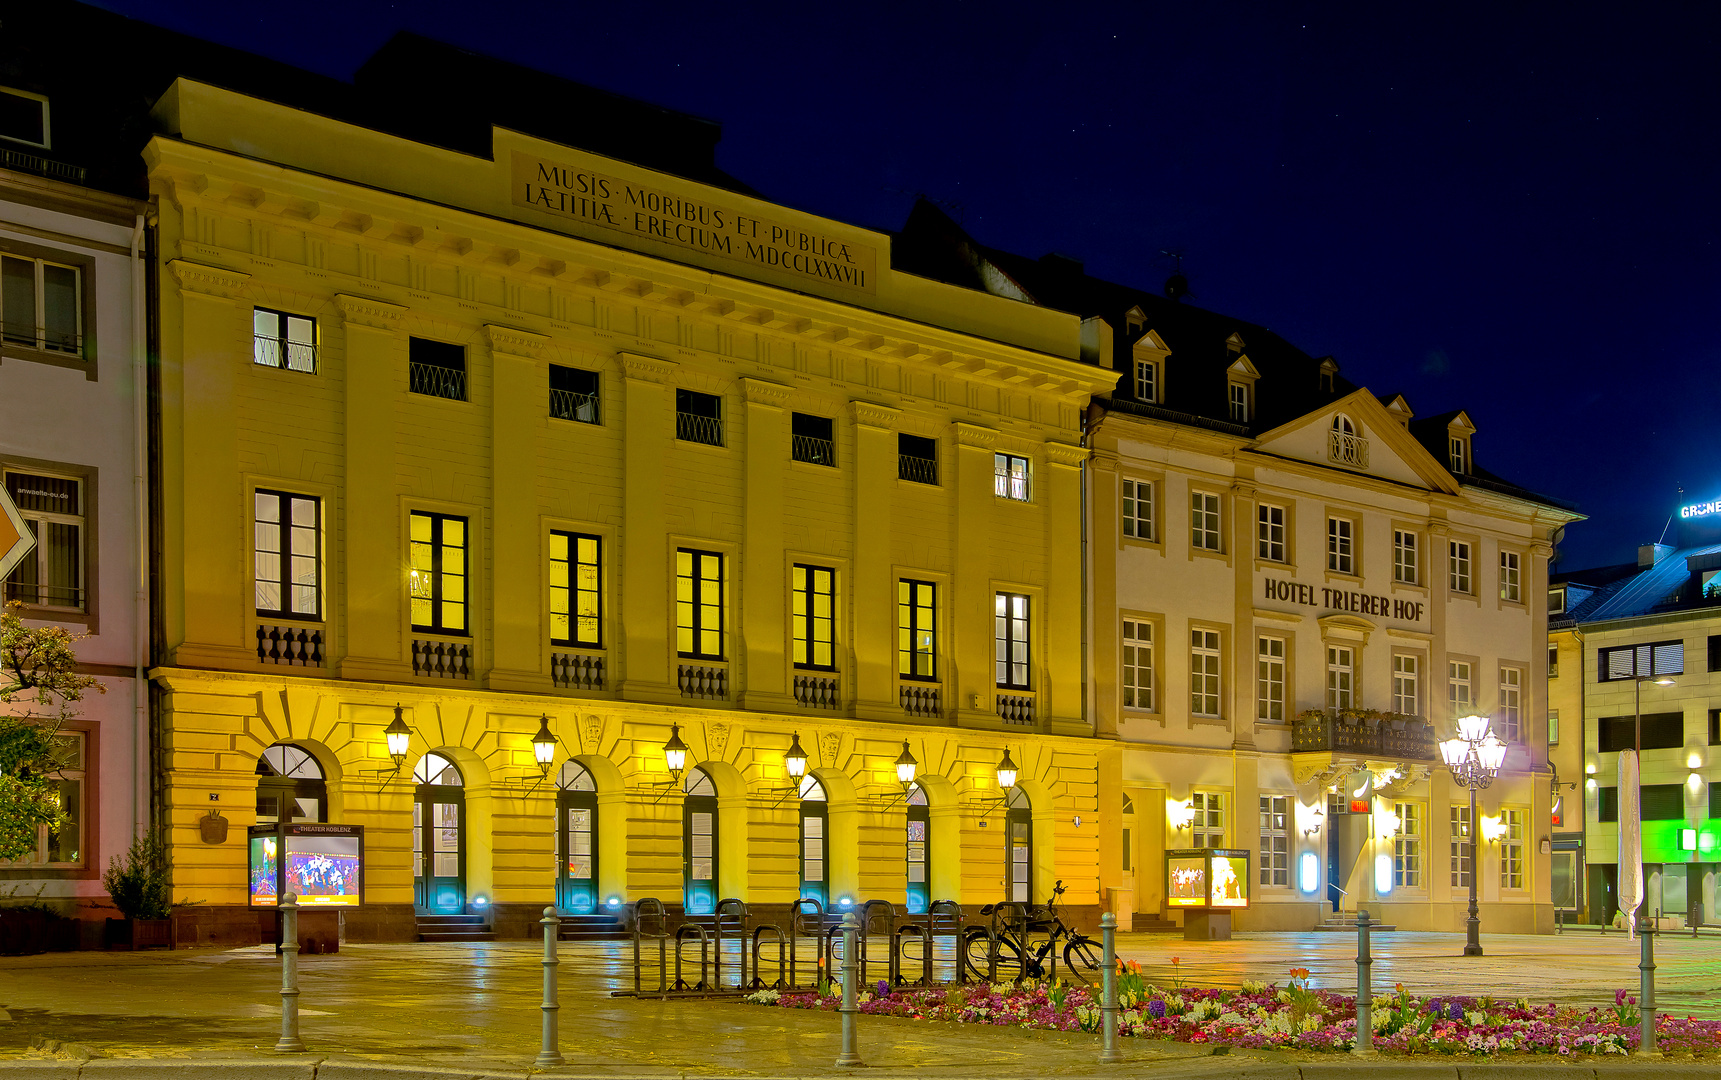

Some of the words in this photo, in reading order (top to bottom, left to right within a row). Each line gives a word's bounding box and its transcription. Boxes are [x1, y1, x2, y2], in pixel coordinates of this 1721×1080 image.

[525, 183, 620, 226] LÆTITIÆ
[634, 213, 732, 254] ERECTUM
[745, 240, 865, 287] MDCCLXXXVII
[537, 162, 611, 199] MUSIS
[624, 186, 725, 229] MORIBUS
[737, 216, 760, 239] ET
[772, 225, 856, 264] PUBLICÆ
[17, 488, 69, 499] anwaelte-eu.de
[1265, 578, 1318, 606] HOTEL
[1322, 588, 1390, 617] TRIERER
[1394, 599, 1424, 621] HOF
